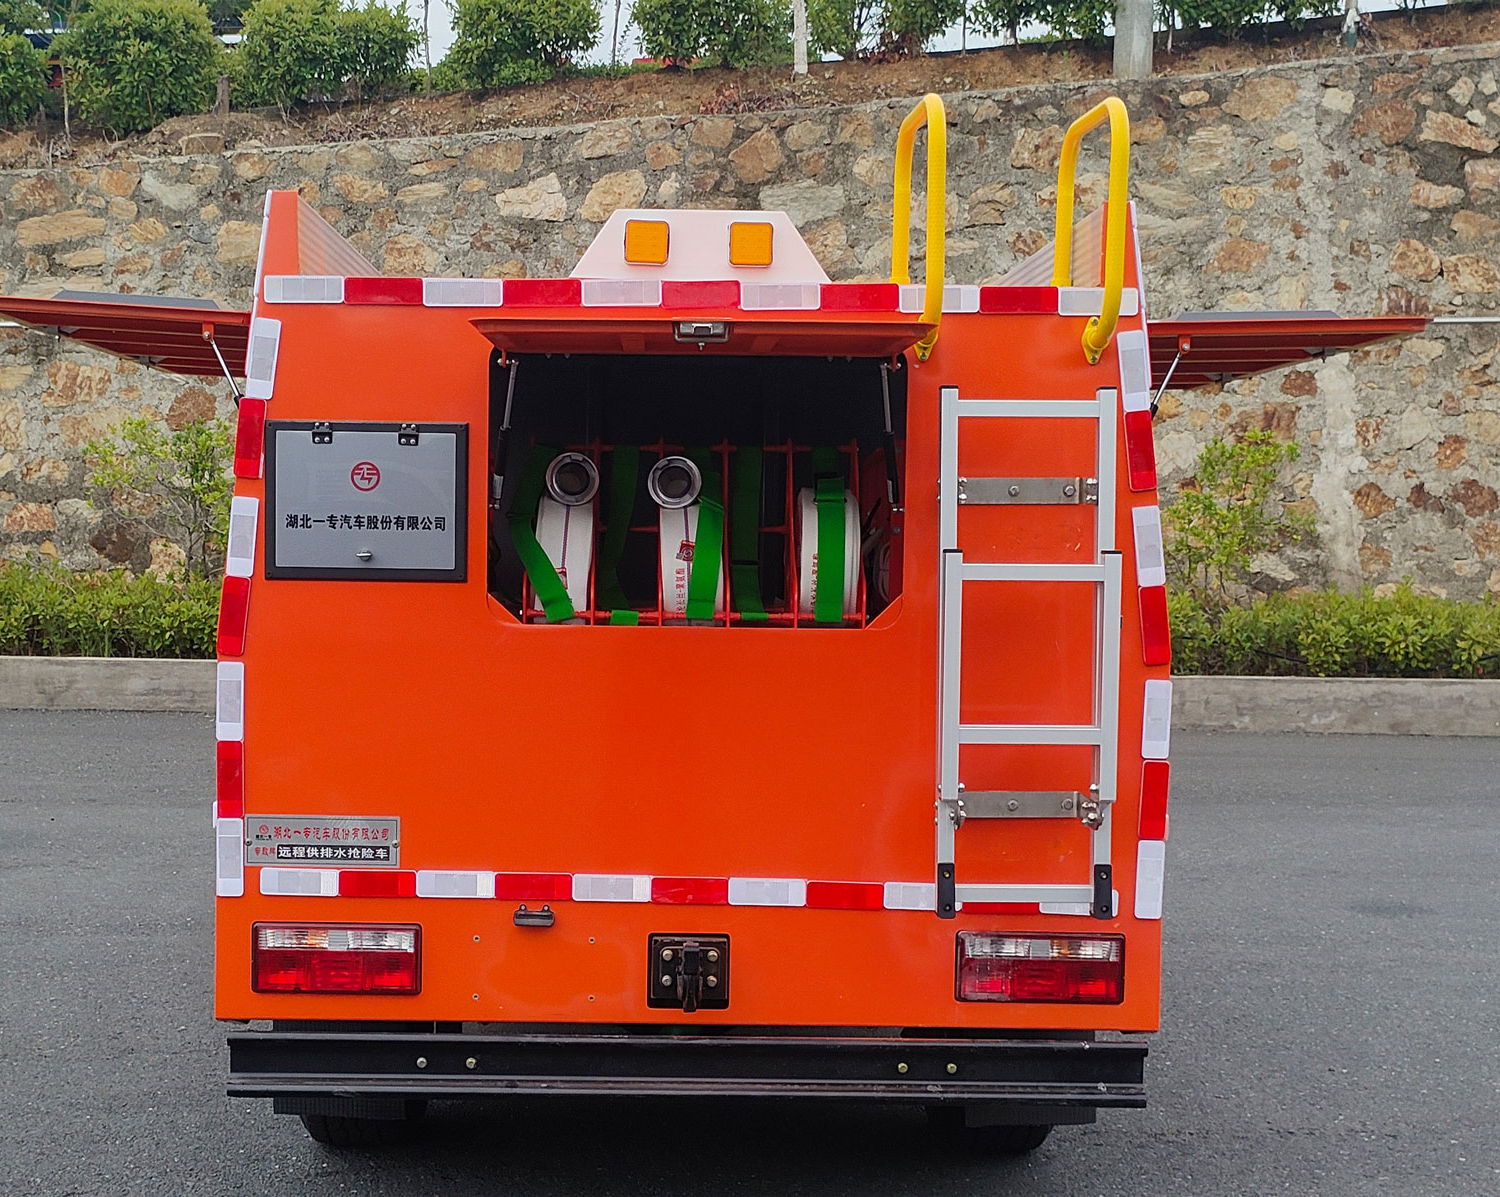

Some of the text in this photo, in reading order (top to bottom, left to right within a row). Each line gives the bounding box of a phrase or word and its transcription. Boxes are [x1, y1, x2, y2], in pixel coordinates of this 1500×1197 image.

[285, 513, 447, 532] 湖北一专汽车股份有限公司
[273, 825, 389, 841] 湖北一专汽车股份有限公司
[278, 846, 389, 860] 远程供排水抢险车
